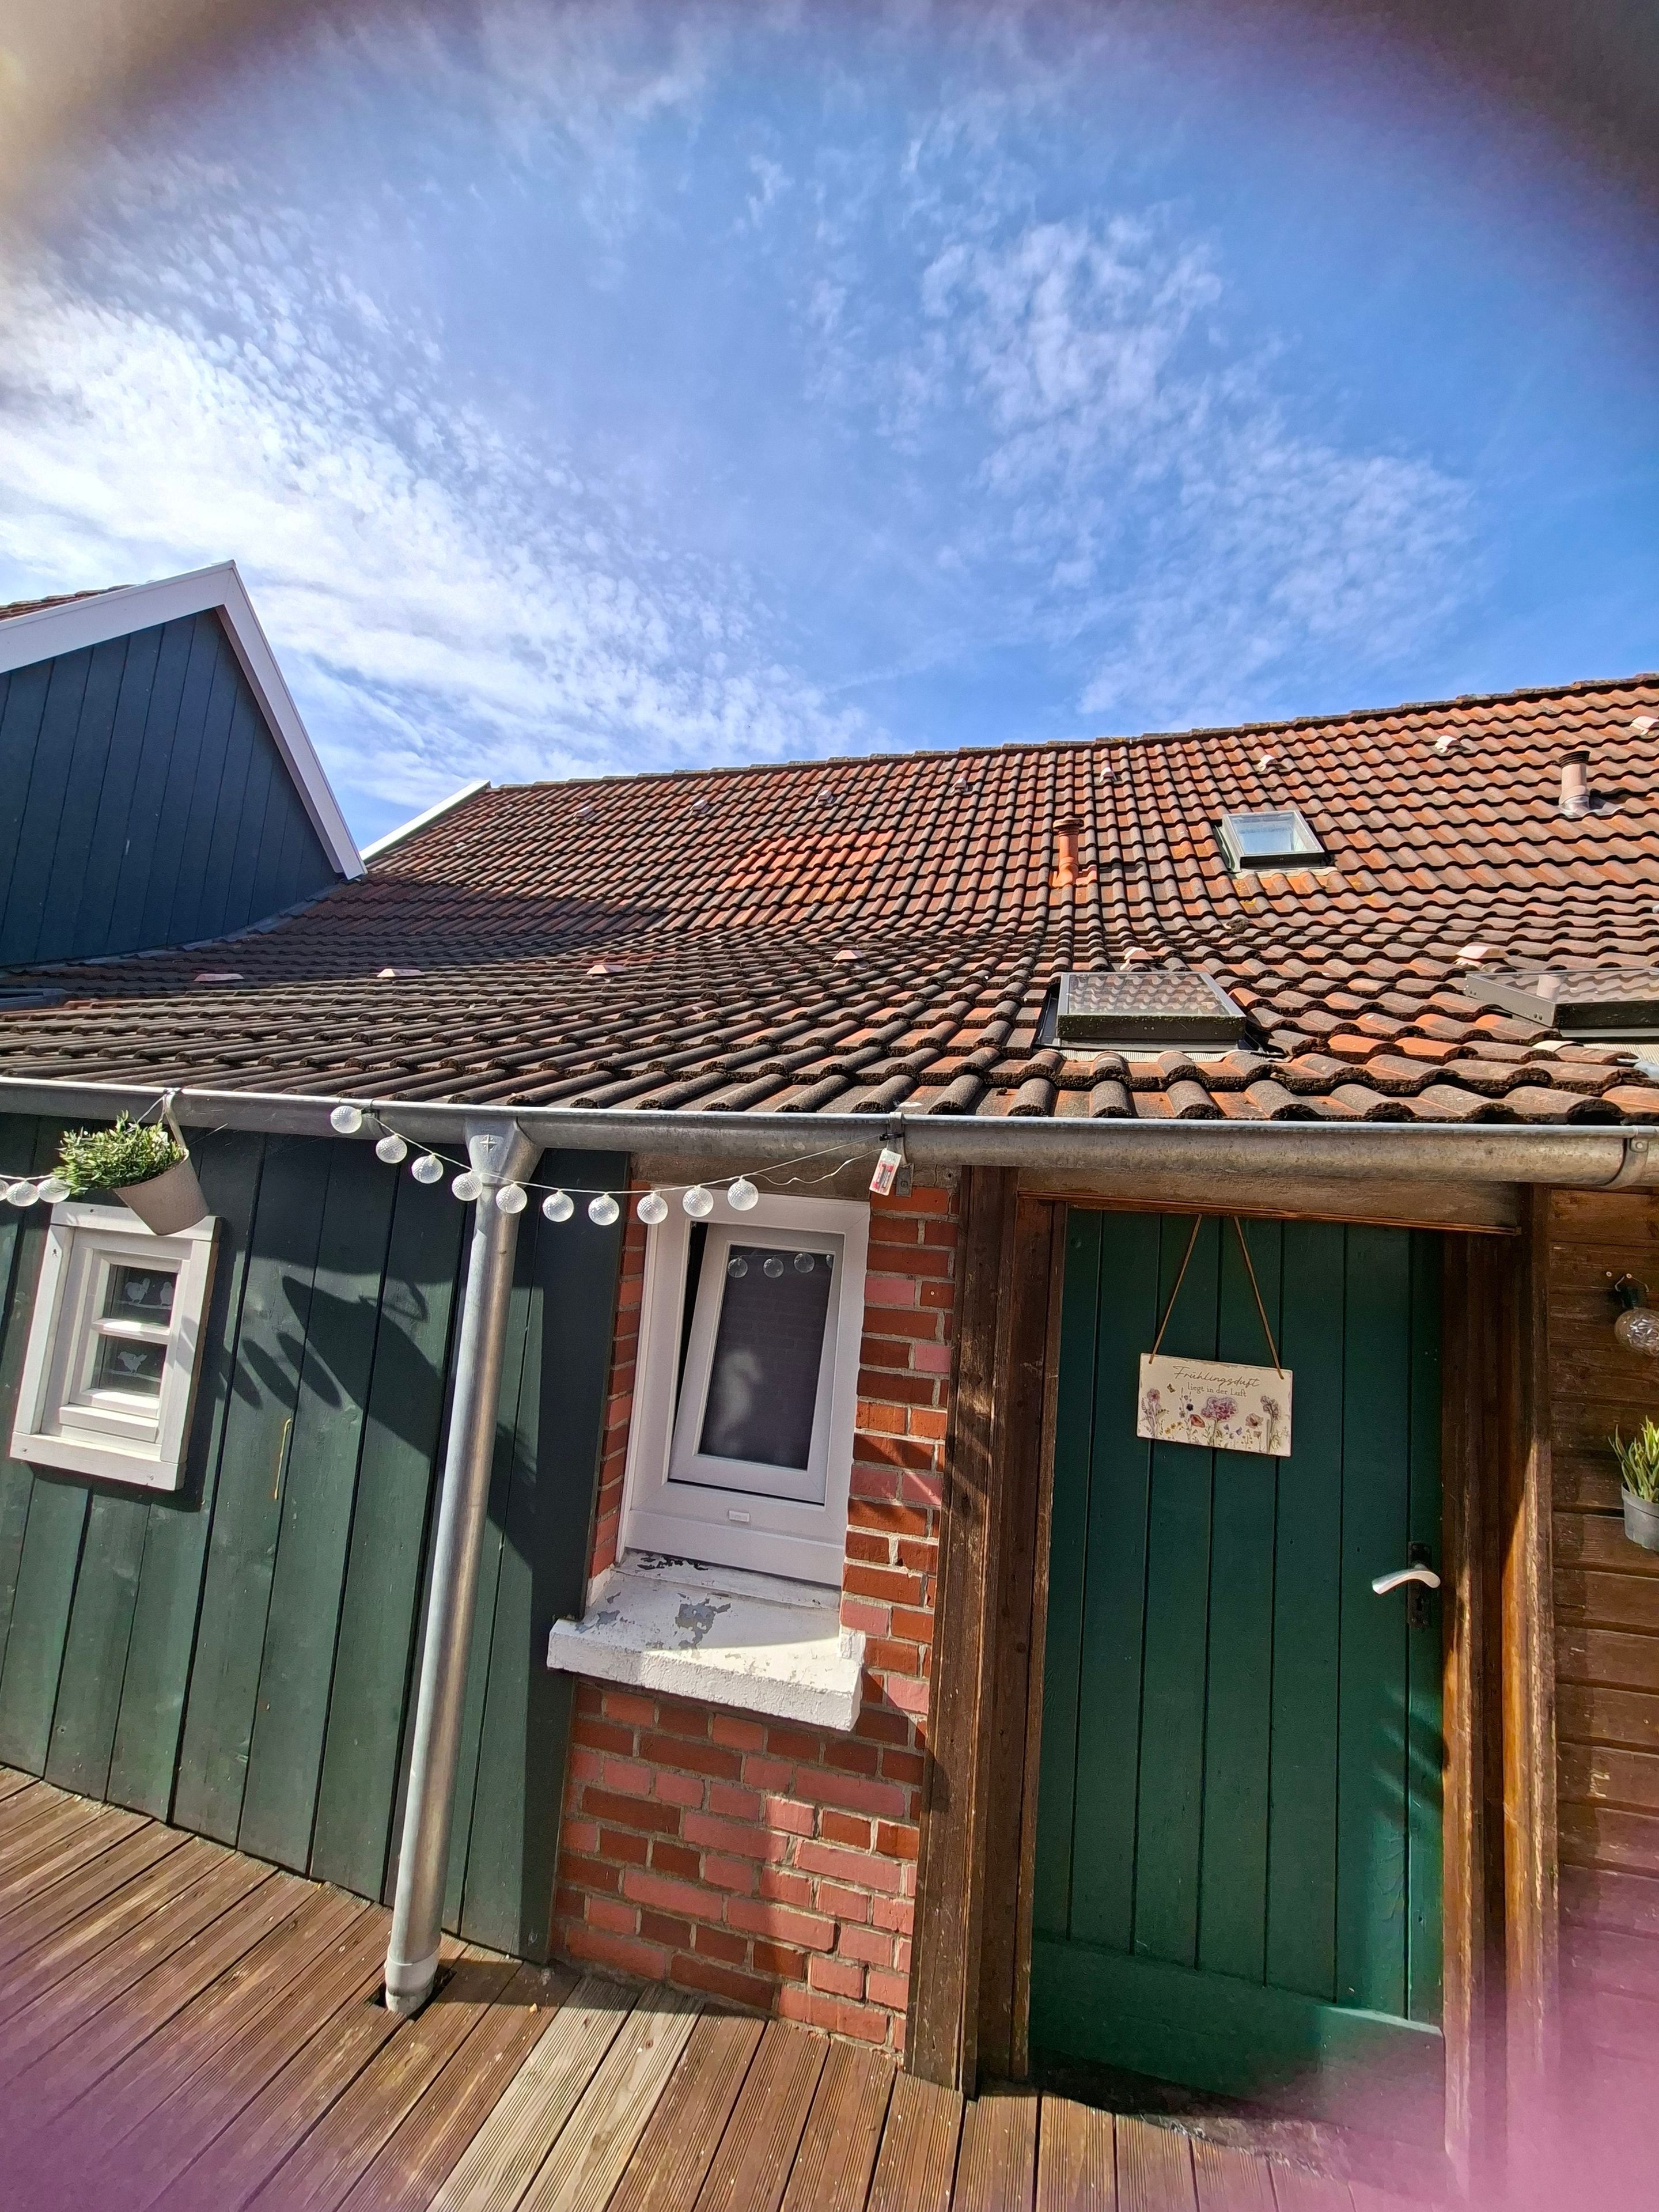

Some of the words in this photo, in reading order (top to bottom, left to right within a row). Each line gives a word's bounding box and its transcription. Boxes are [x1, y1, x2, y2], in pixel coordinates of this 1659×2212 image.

[1173, 1366, 1260, 1388] Frühlingsduft
[1187, 1382, 1204, 1394] liegt
[1216, 1385, 1228, 1395] der
[1230, 1388, 1247, 1397] Luft
